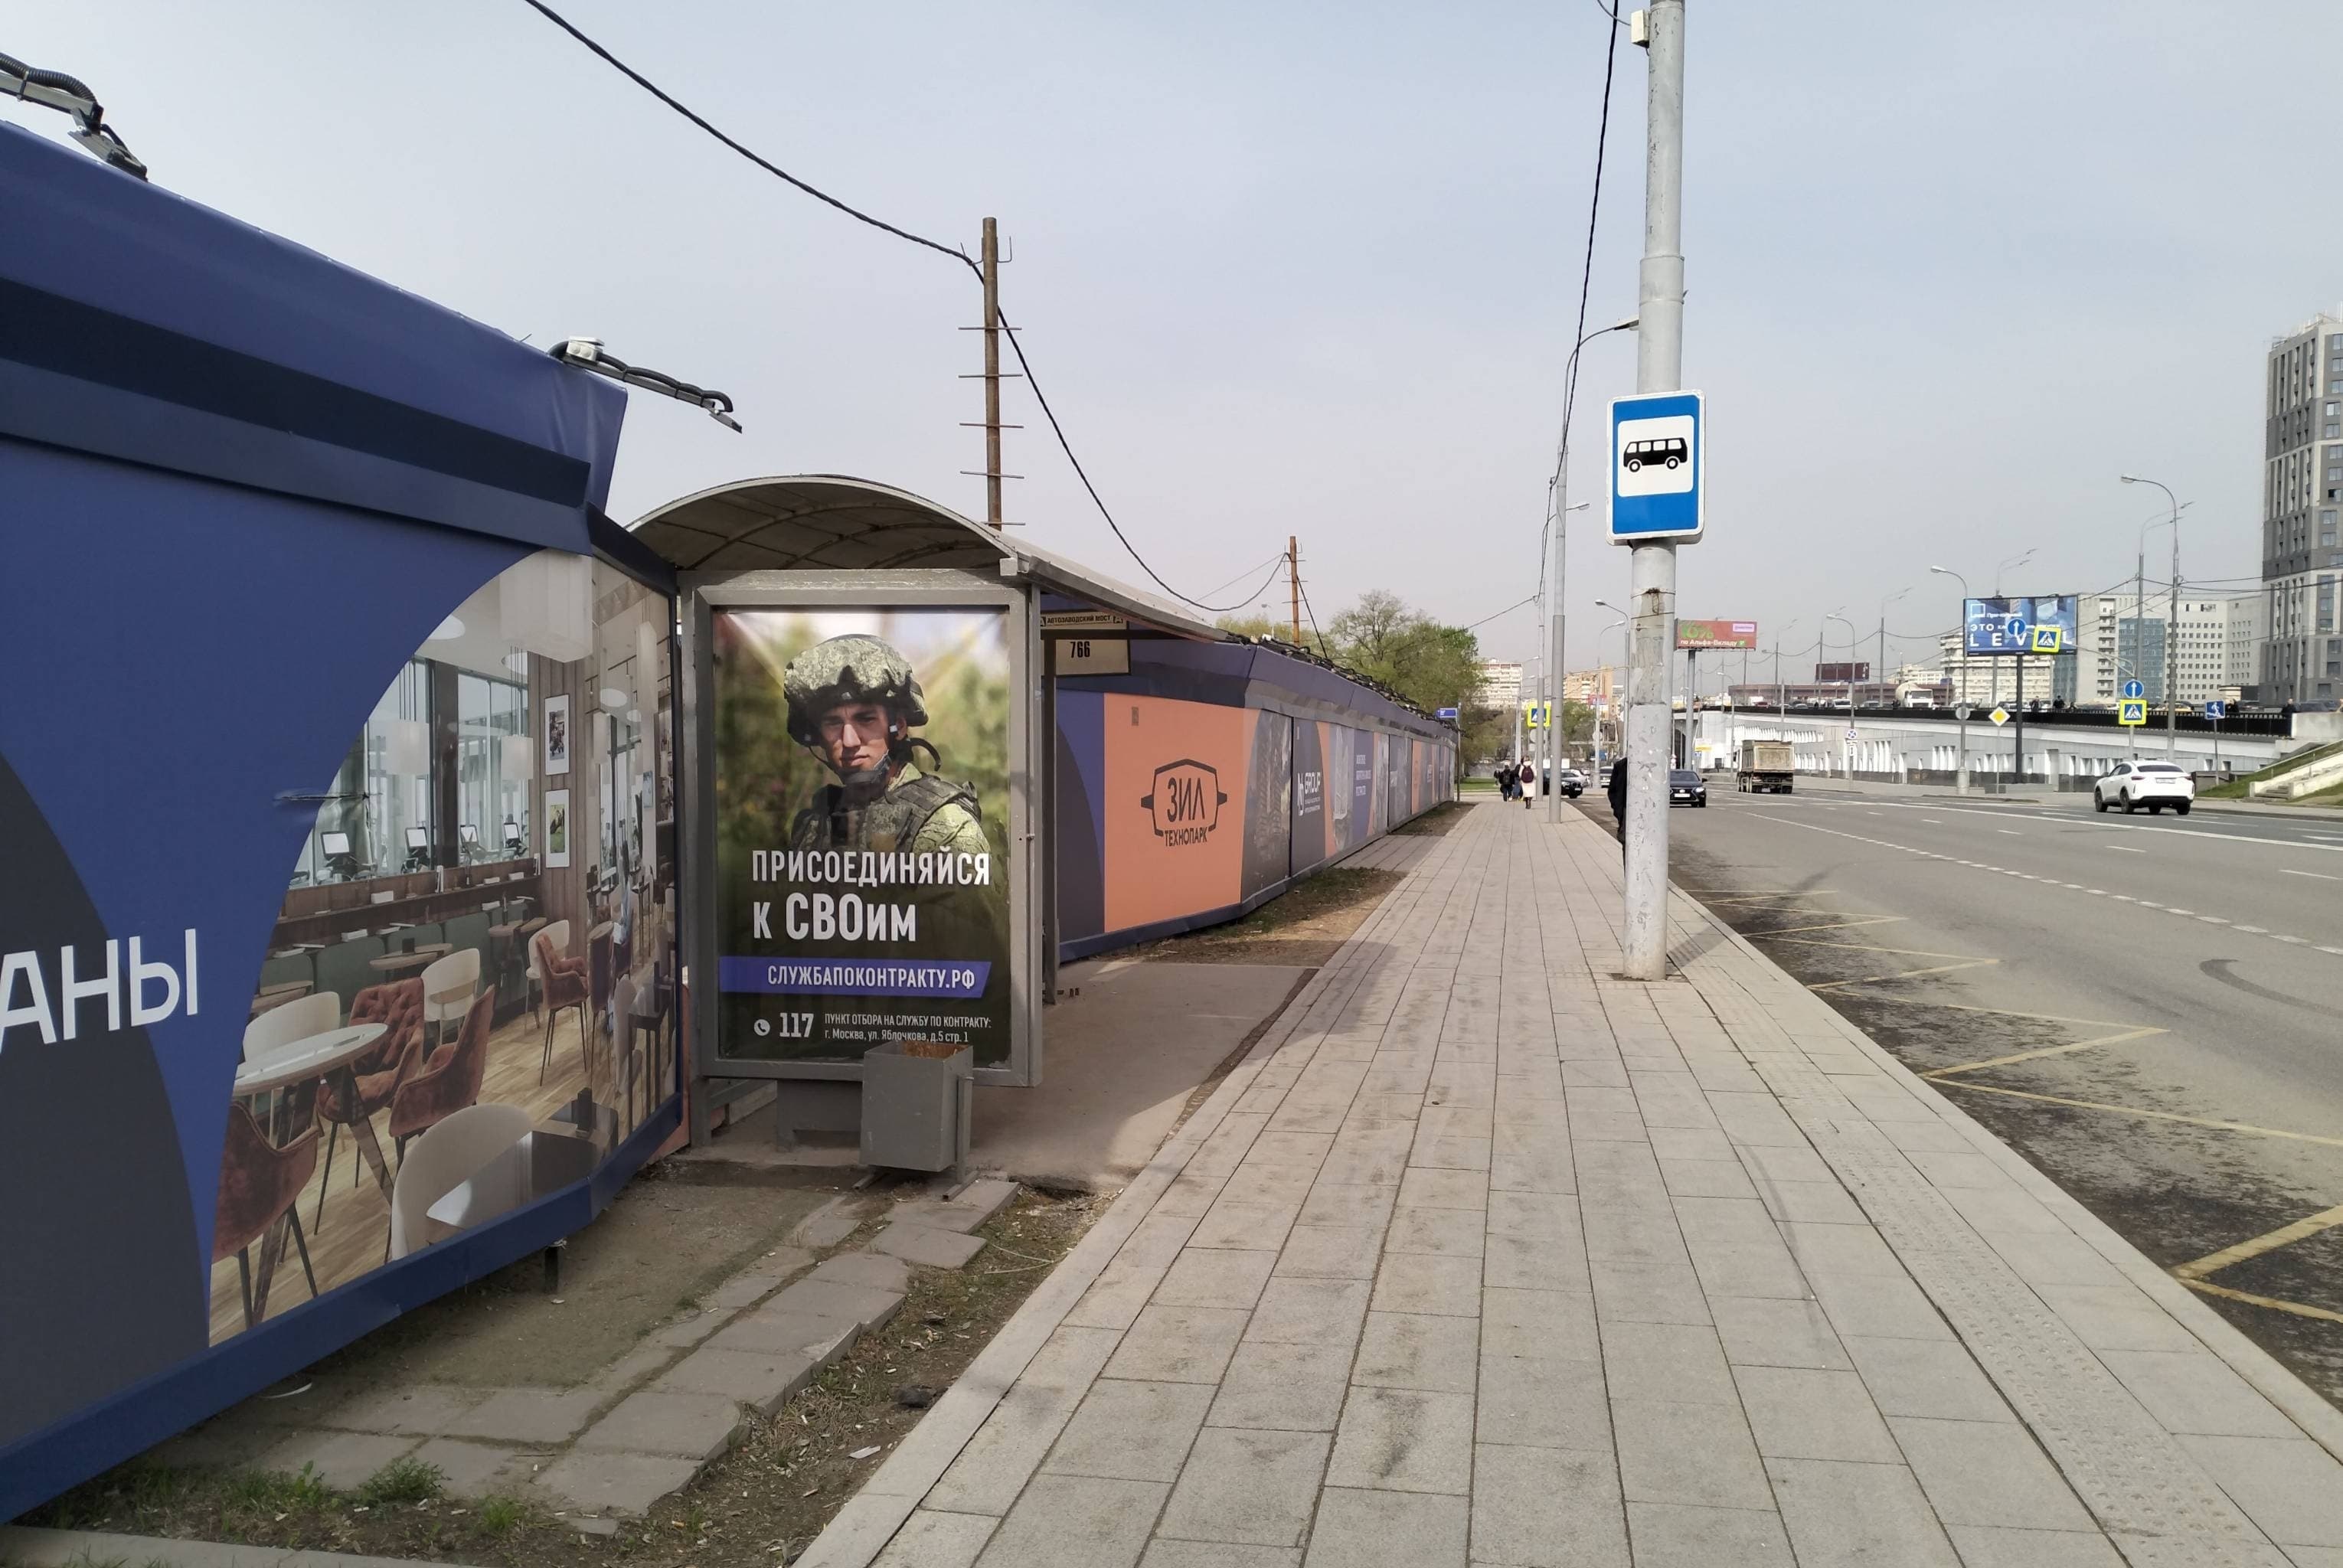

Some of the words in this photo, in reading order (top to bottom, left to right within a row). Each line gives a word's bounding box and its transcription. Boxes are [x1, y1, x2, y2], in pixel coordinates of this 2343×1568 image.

[1047, 615, 1094, 623] АВТОЗАВОДСКИЙ
[1969, 631, 2072, 647] LEVL
[1070, 641, 1090, 658] 766
[1305, 772, 1321, 794] GROUP
[1167, 777, 1205, 822] ЗИЛ
[1165, 827, 1208, 847] ТЕХНОПАРК
[752, 846, 990, 887] ПРИСОЕДИНЯЙСЯ
[768, 965, 975, 989] СЛУЖБАПОКОНТРАКТУ.РФ
[779, 1012, 814, 1037] 117
[825, 1014, 851, 1024] ПУНКТ
[851, 1014, 882, 1025] ОТБОРА
[884, 1015, 894, 1026] НА
[896, 1015, 929, 1027] СЛУЖБУ
[930, 1016, 942, 1027] ПО
[943, 1016, 992, 1028] КОНТРАКТУ:
[825, 1030, 831, 1039] г.
[832, 1028, 866, 1040] Москва,
[868, 1031, 880, 1041] ул.
[881, 1029, 930, 1042] Яблочкова,
[930, 1031, 943, 1043] д.5
[945, 1033, 962, 1044] стр.
[963, 1032, 969, 1042] 1
